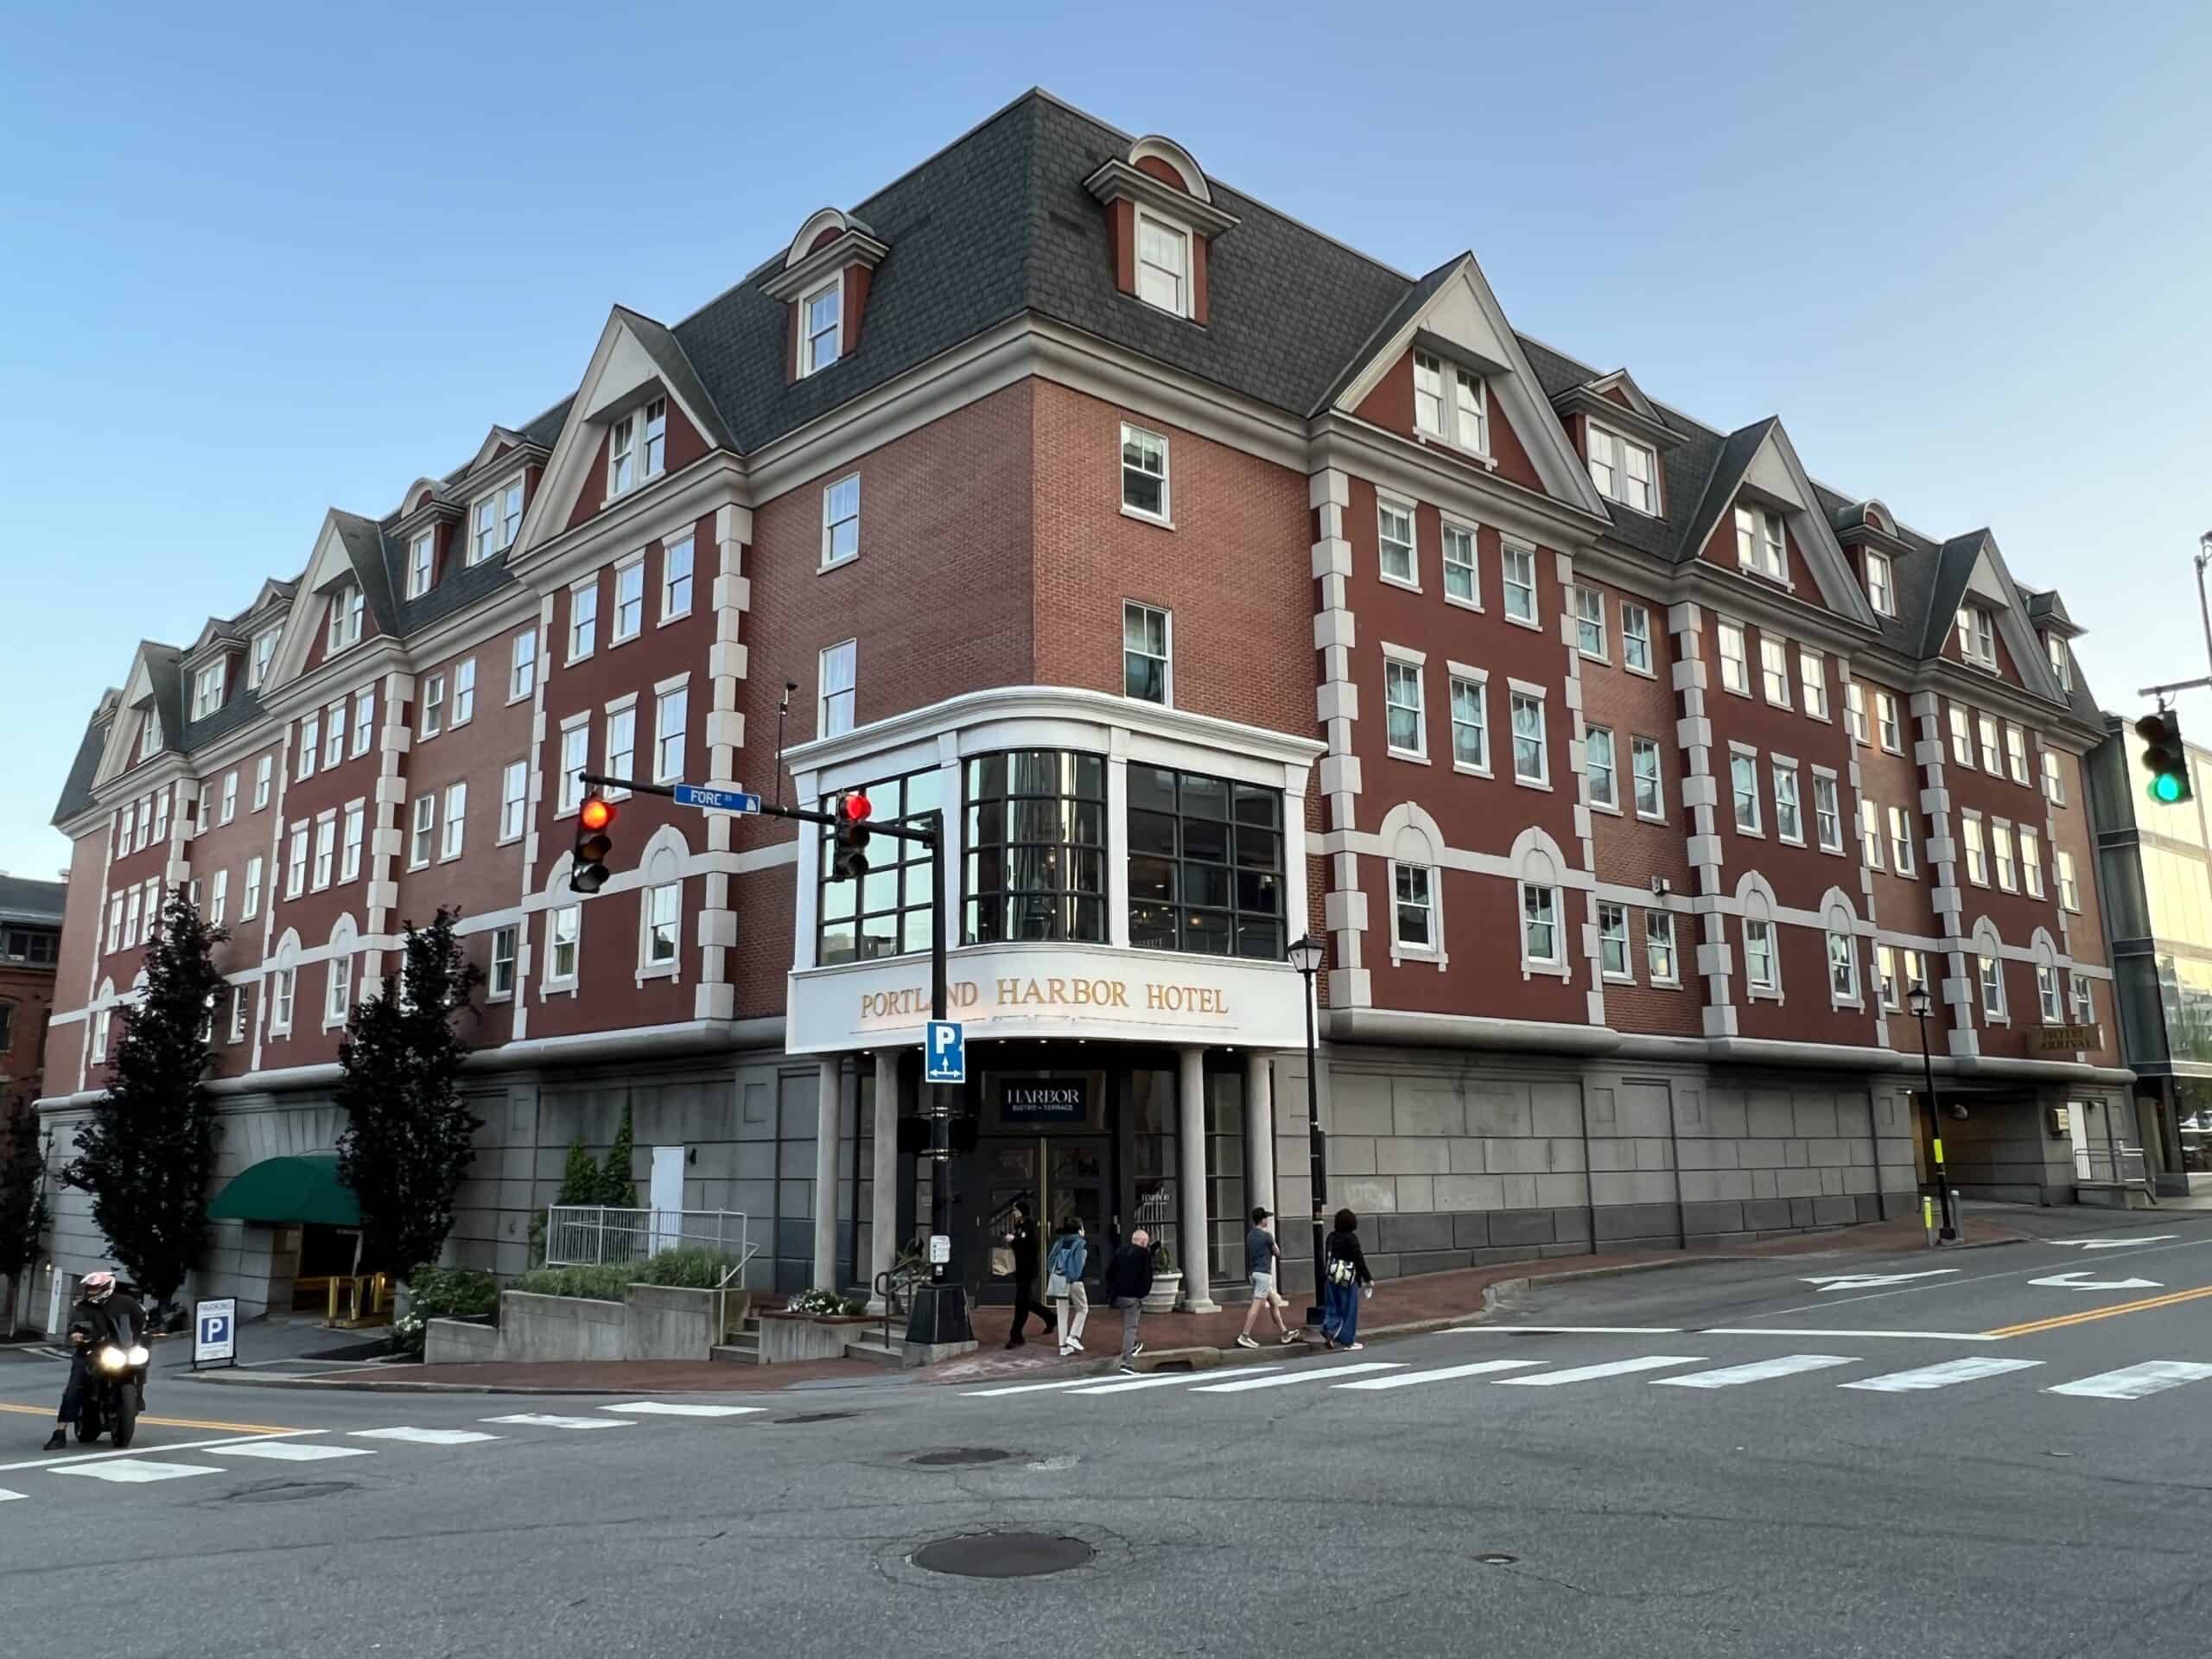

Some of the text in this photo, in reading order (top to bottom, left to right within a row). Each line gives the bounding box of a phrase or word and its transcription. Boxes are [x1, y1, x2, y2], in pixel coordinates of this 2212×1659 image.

[861, 977, 1229, 1018] PORTLND HARBOR HOTEL
[936, 1026, 956, 1054] P
[1007, 1089, 1079, 1103] HARBOR
[207, 1319, 223, 1342] P
